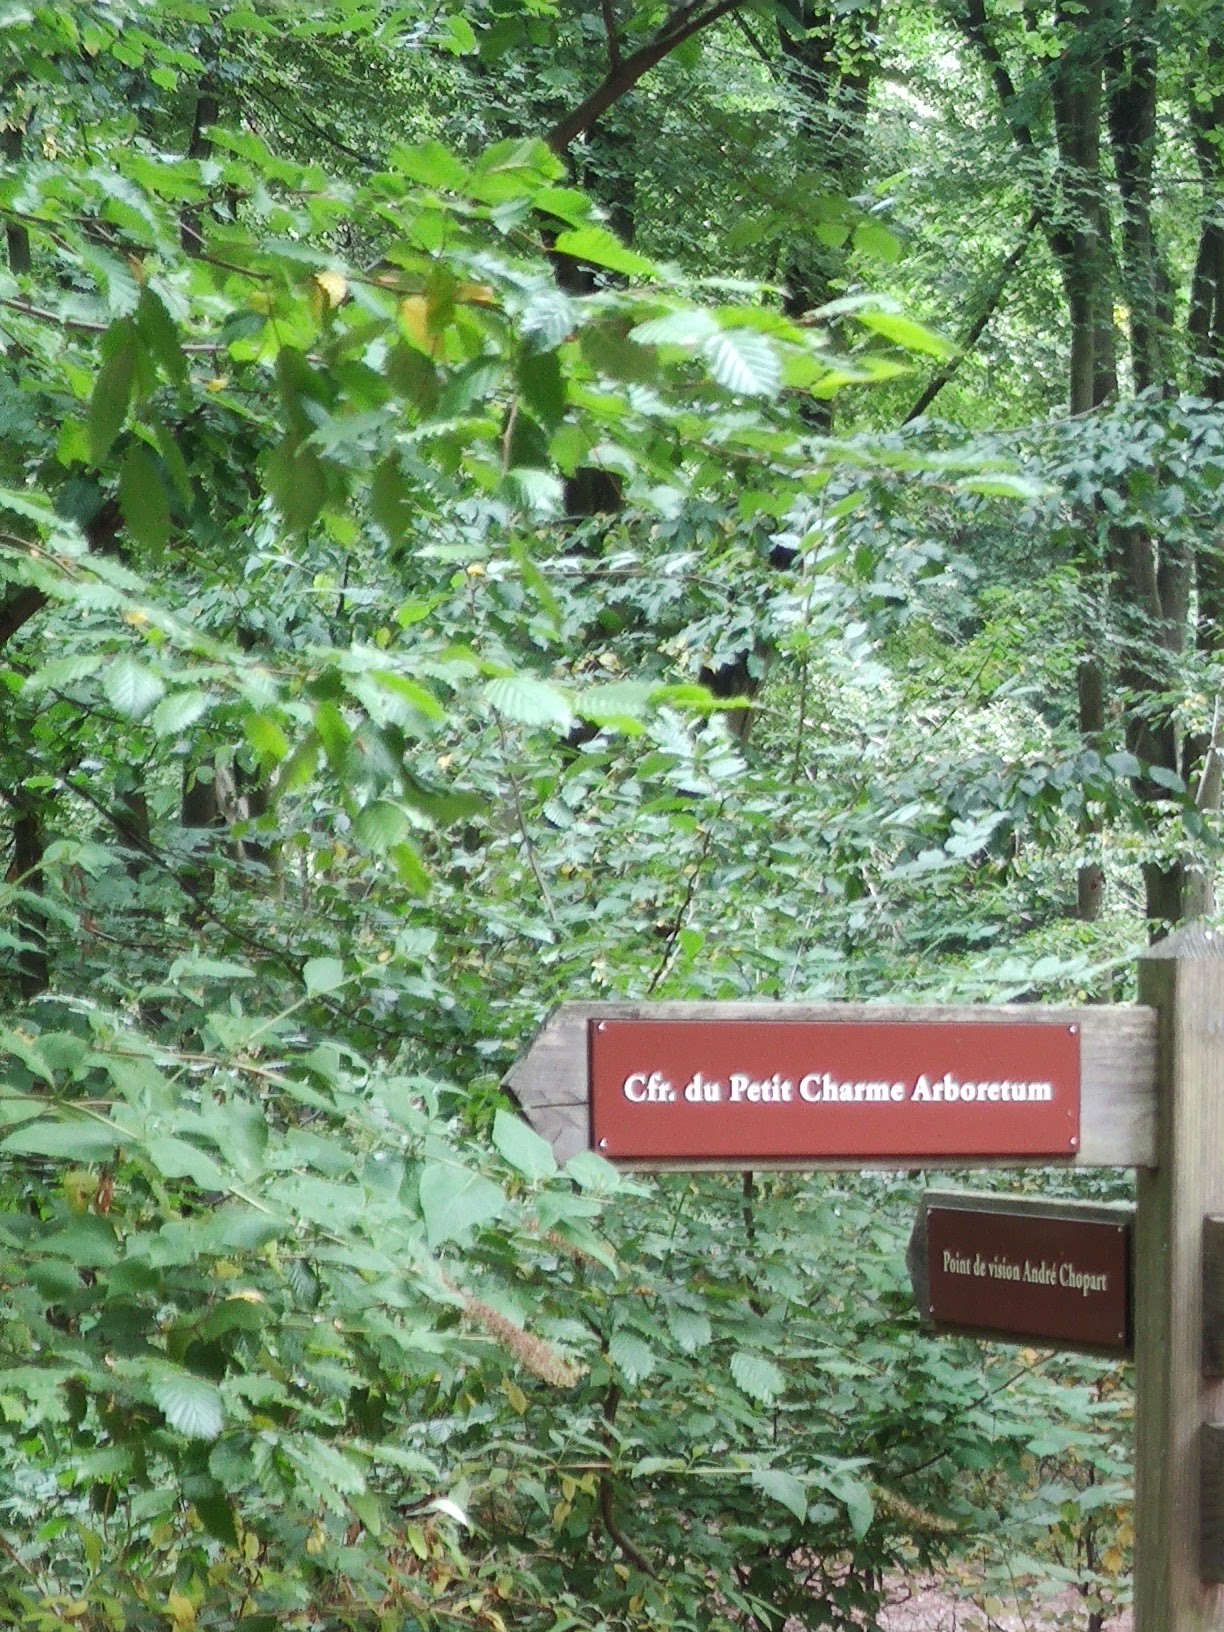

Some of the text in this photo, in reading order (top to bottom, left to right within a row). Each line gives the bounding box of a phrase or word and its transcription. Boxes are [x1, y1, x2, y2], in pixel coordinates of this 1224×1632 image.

[624, 1071, 1054, 1103] Cfr. du Petit Charme Arboretum
[942, 1250, 1108, 1297] Point de vision André Chopart
